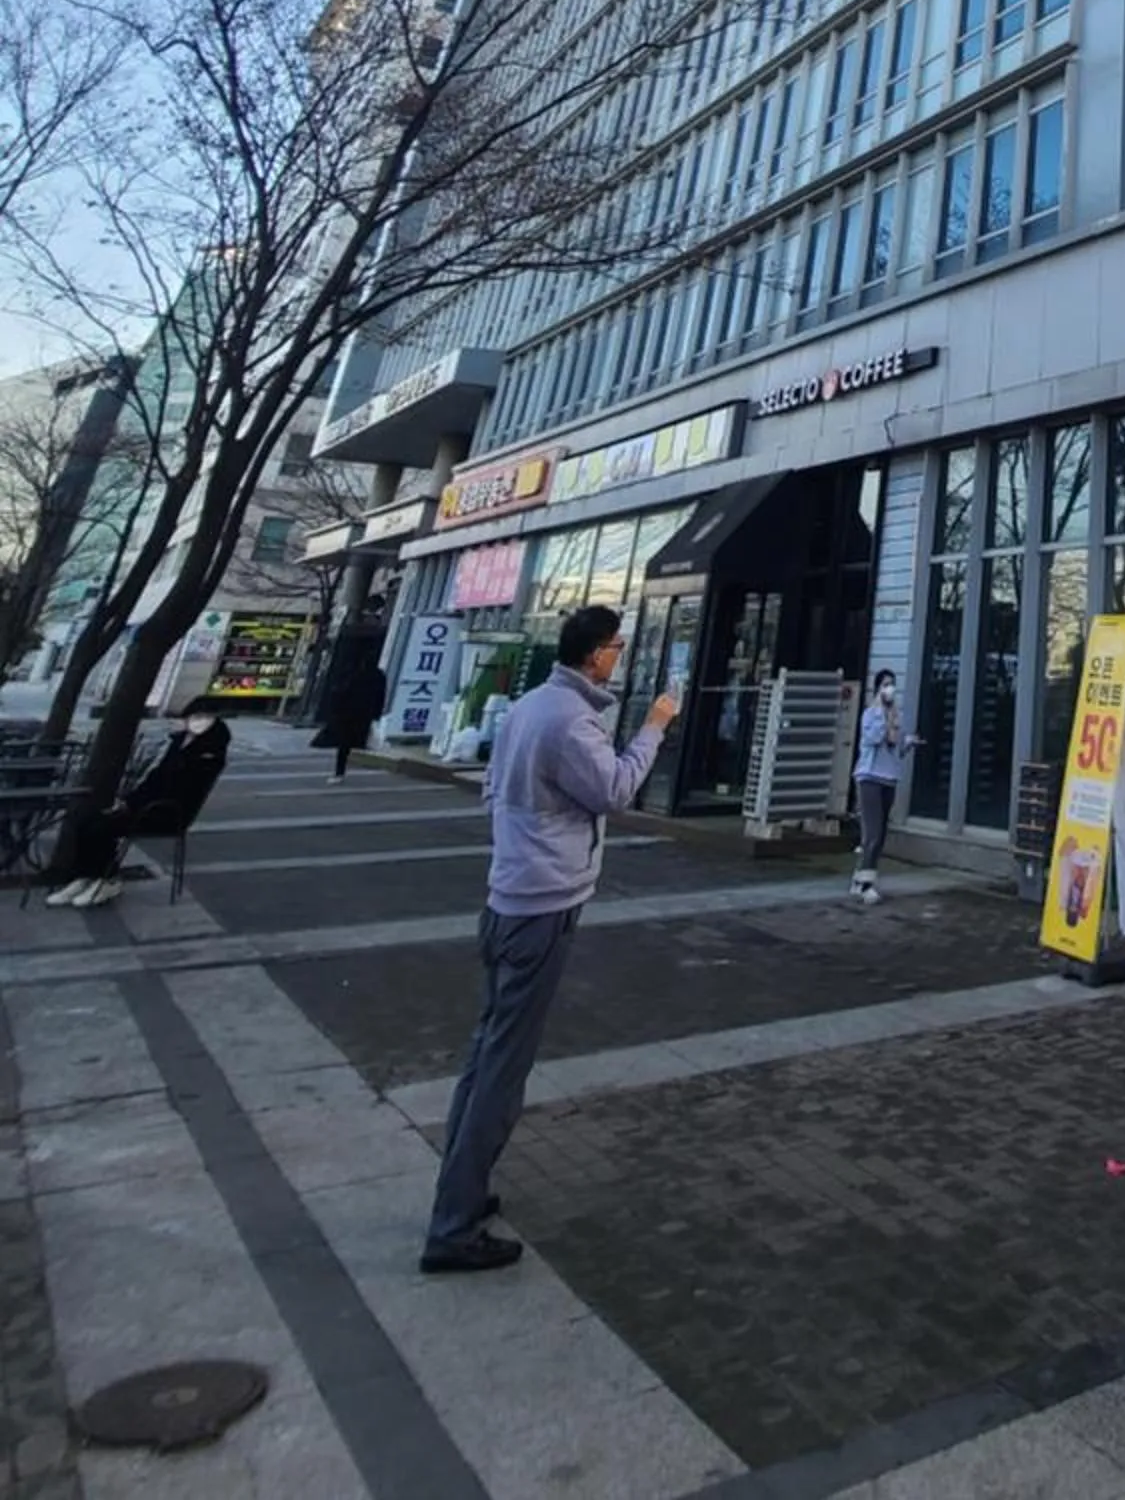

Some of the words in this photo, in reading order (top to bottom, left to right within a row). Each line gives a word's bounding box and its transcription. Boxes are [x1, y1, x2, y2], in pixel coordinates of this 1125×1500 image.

[758, 376, 819, 417] SELECTO
[839, 348, 904, 392] COFFEE
[399, 622, 449, 733] 오피스텔
